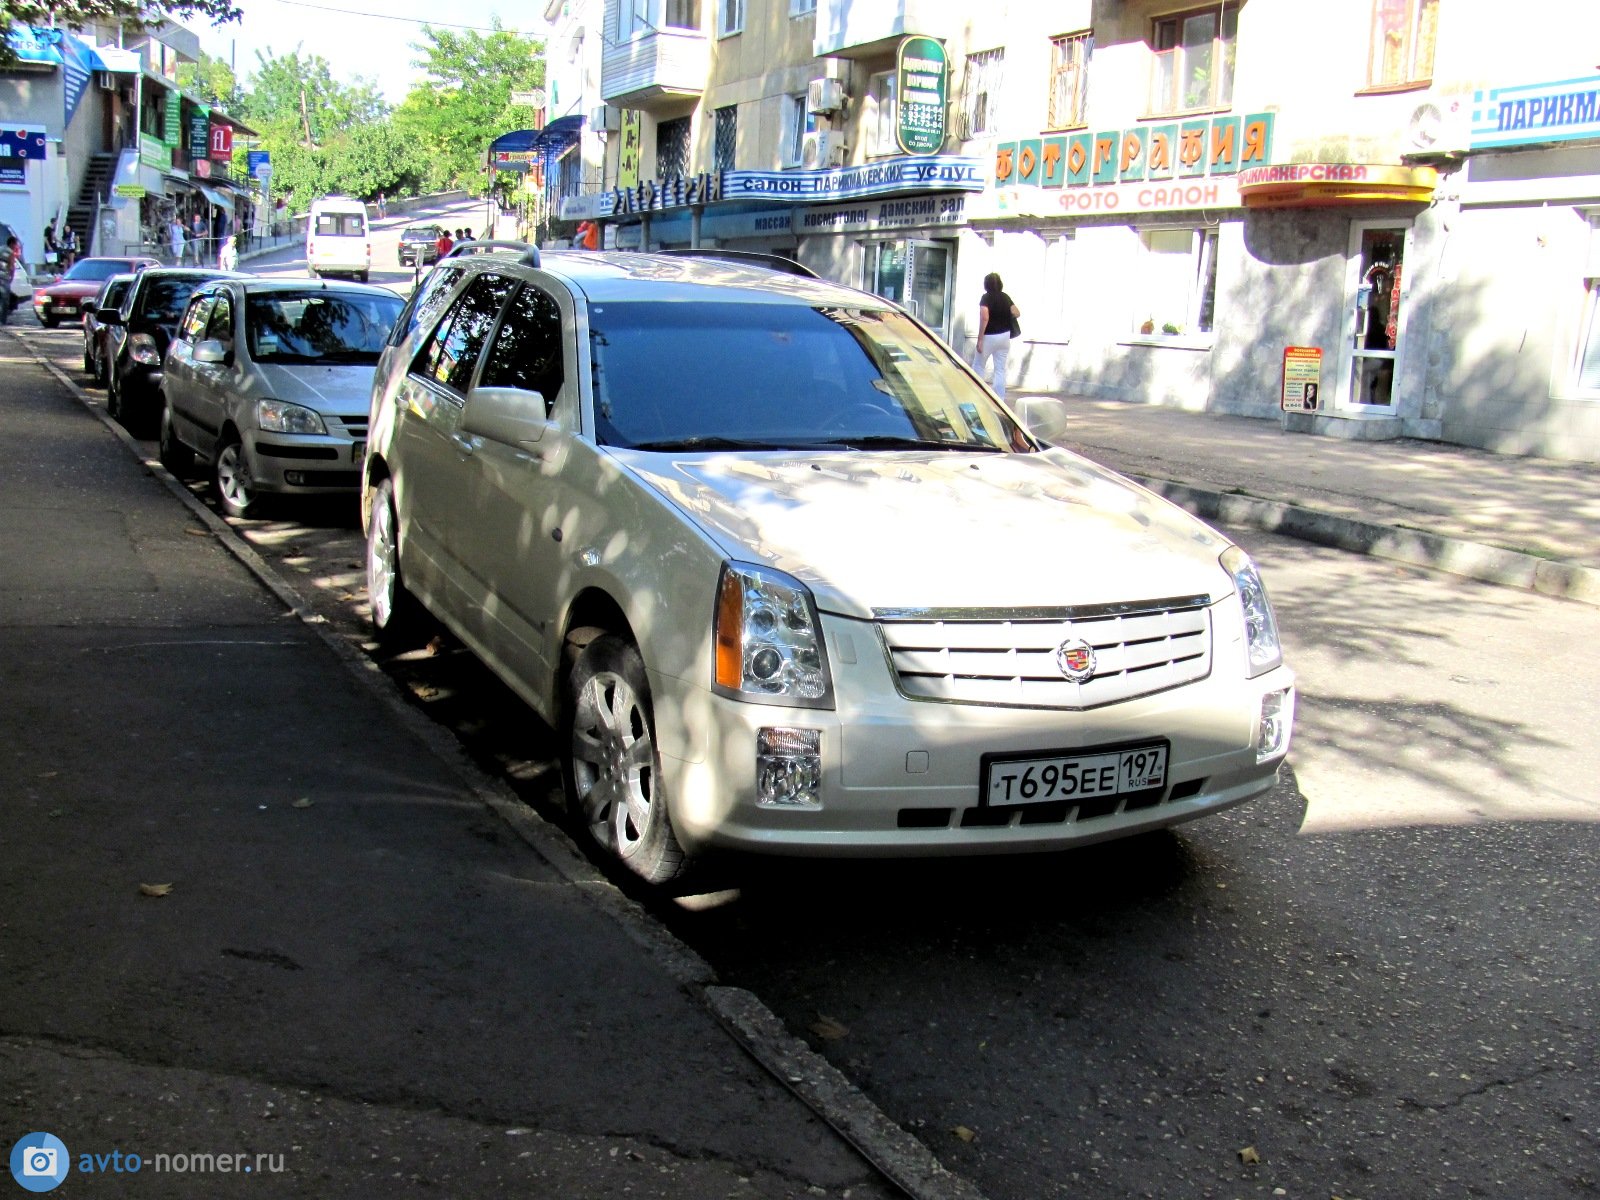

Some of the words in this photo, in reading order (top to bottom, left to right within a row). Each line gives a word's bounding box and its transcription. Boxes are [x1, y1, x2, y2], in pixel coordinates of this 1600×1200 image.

[1497, 91, 1600, 132] ПАРИКМ
[995, 120, 1267, 181] ФОТОГРАФИЯ
[743, 179, 801, 192] салон
[813, 164, 904, 192] ПАРИКМАХЕРСКИХ
[917, 166, 977, 182] услуг
[940, 197, 966, 213] зал
[1059, 191, 1119, 211] ФОТО
[1138, 185, 1219, 208] САЛОН
[804, 209, 869, 226] косметолог
[1122, 751, 1159, 779] 197
[1128, 777, 1147, 788] RUS
